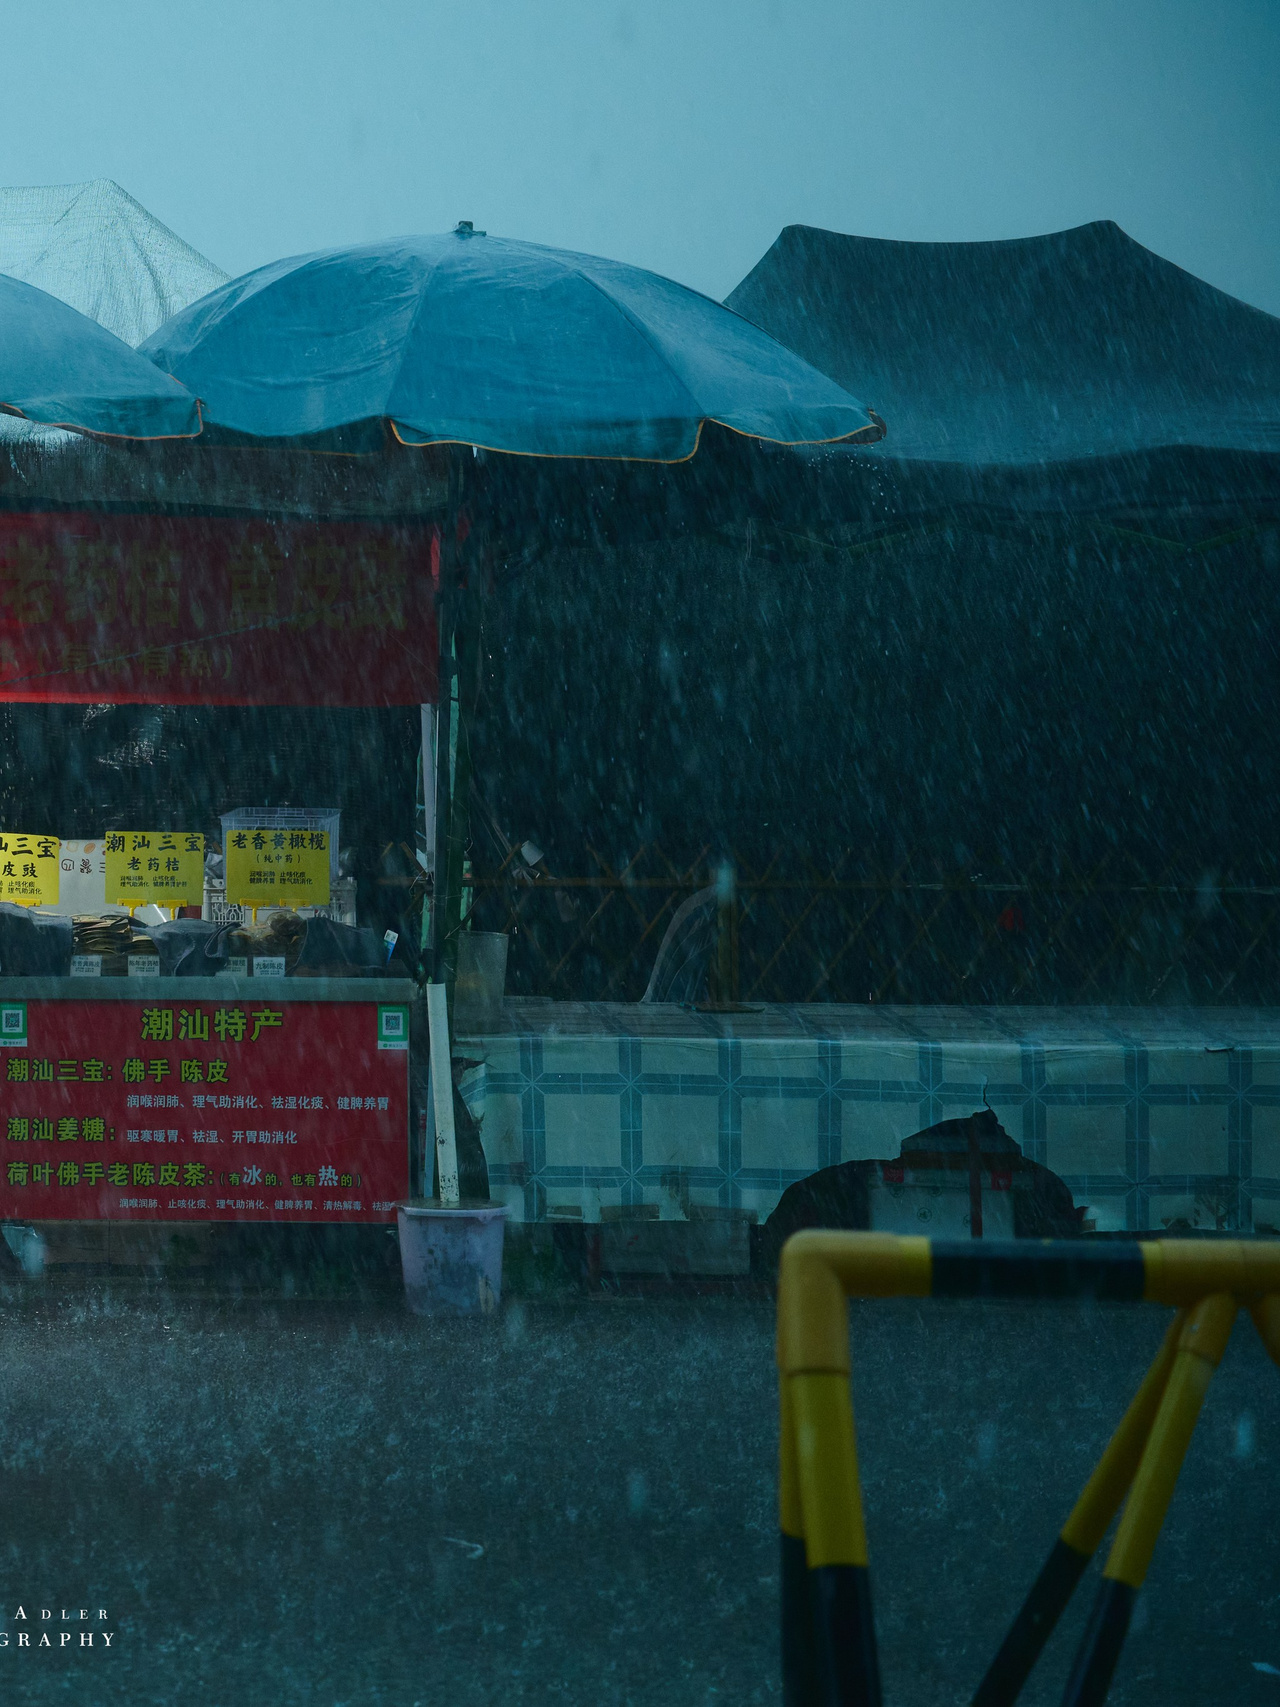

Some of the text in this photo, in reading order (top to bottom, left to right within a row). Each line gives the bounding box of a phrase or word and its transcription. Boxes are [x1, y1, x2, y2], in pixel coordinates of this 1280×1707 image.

[106, 833, 201, 853] 潮汕三宝
[232, 832, 326, 850] 老香黄橄榄
[127, 856, 180, 872] 老药桔
[140, 1007, 285, 1043] 潮汕特产
